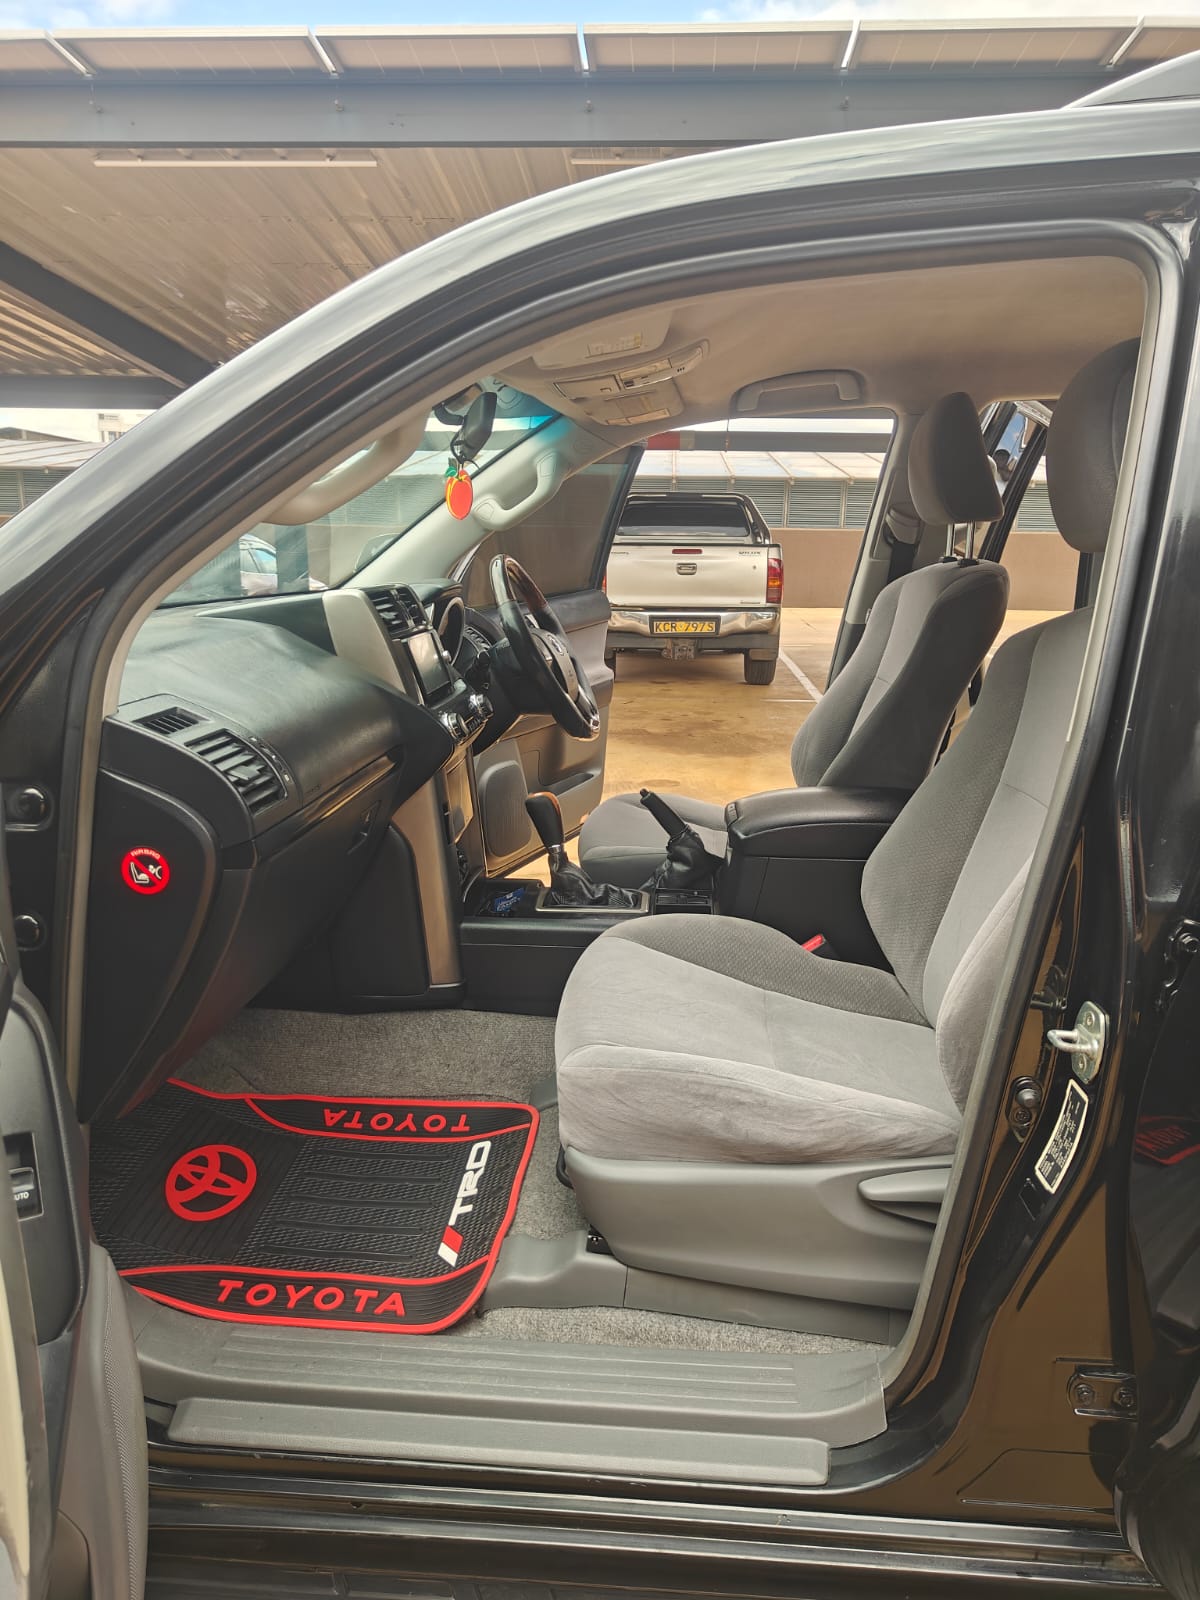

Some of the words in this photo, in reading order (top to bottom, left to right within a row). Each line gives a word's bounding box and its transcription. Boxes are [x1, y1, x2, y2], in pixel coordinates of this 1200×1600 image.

[655, 622, 677, 632] KCR
[323, 1108, 471, 1132] TOYOTA
[448, 1140, 491, 1226] TRD
[14, 1191, 30, 1201] UTO
[217, 1279, 406, 1317] TOYOTA
